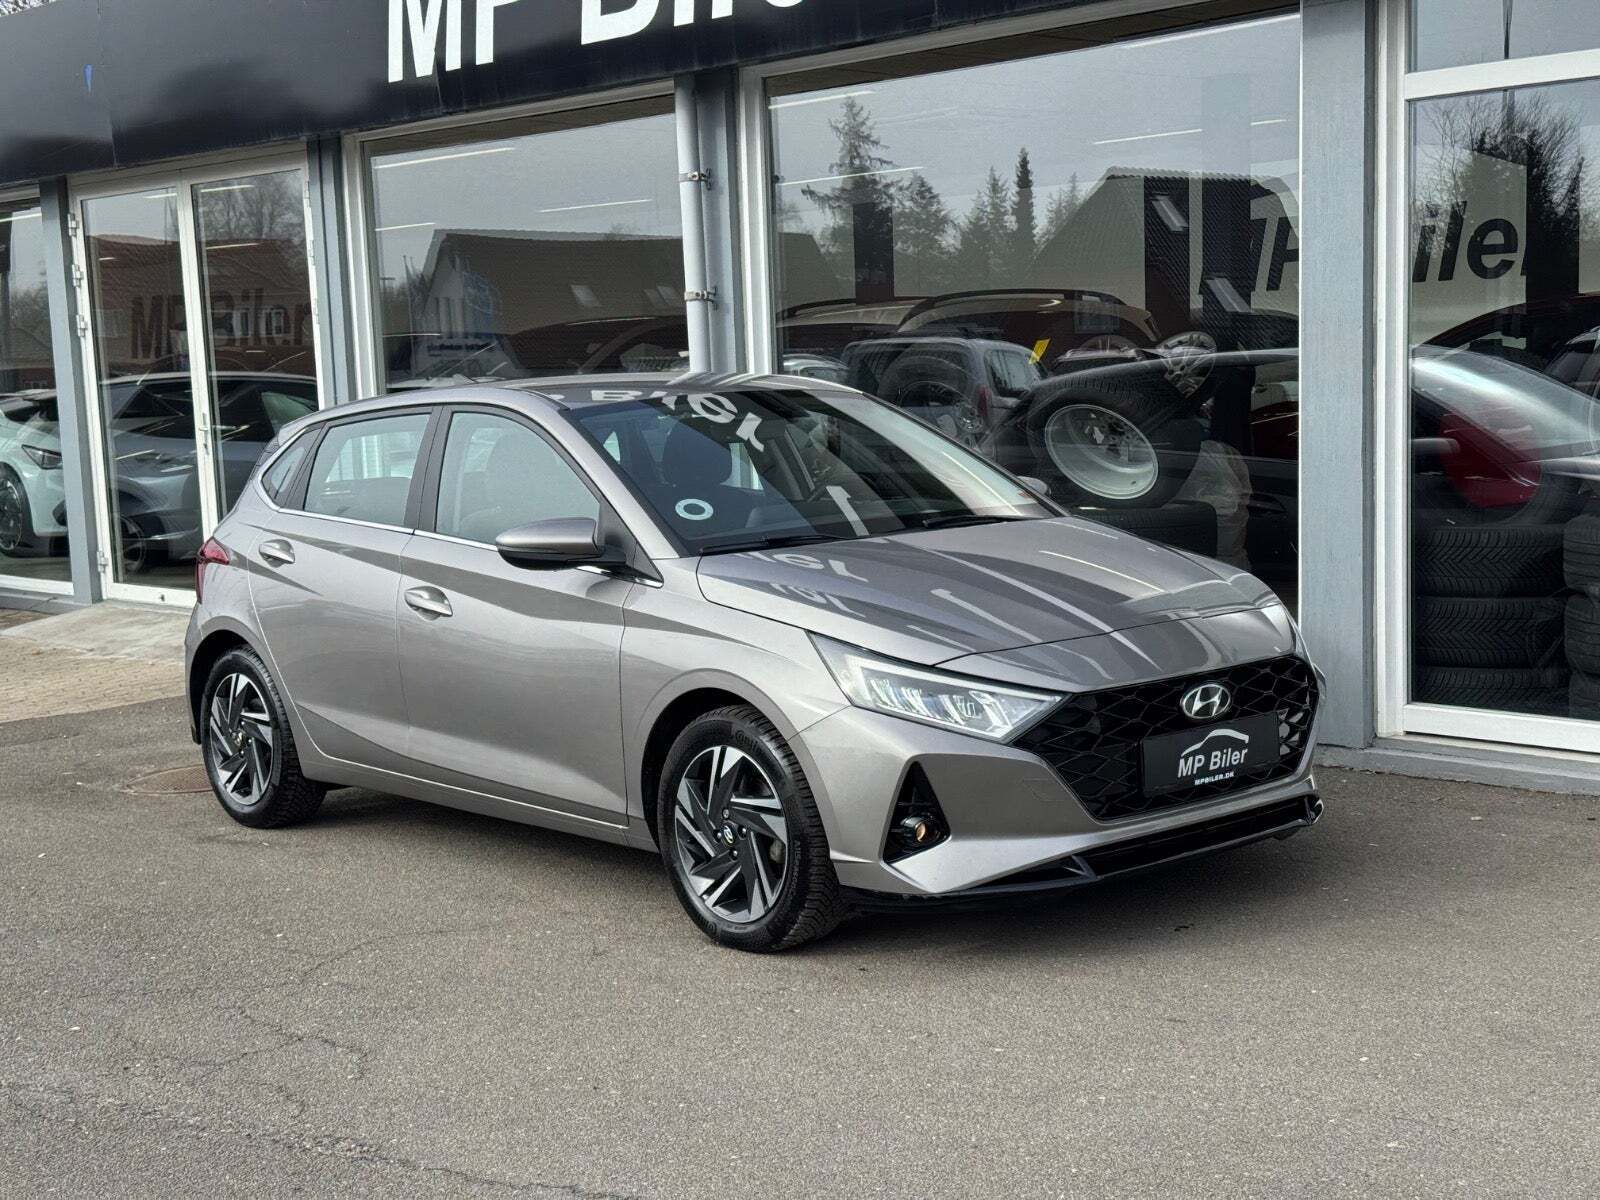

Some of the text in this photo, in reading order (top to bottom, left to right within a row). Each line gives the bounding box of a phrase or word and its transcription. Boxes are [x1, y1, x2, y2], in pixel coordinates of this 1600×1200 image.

[1177, 747, 1248, 778] MP Biler
[1194, 771, 1235, 785] MPBILER.DK
